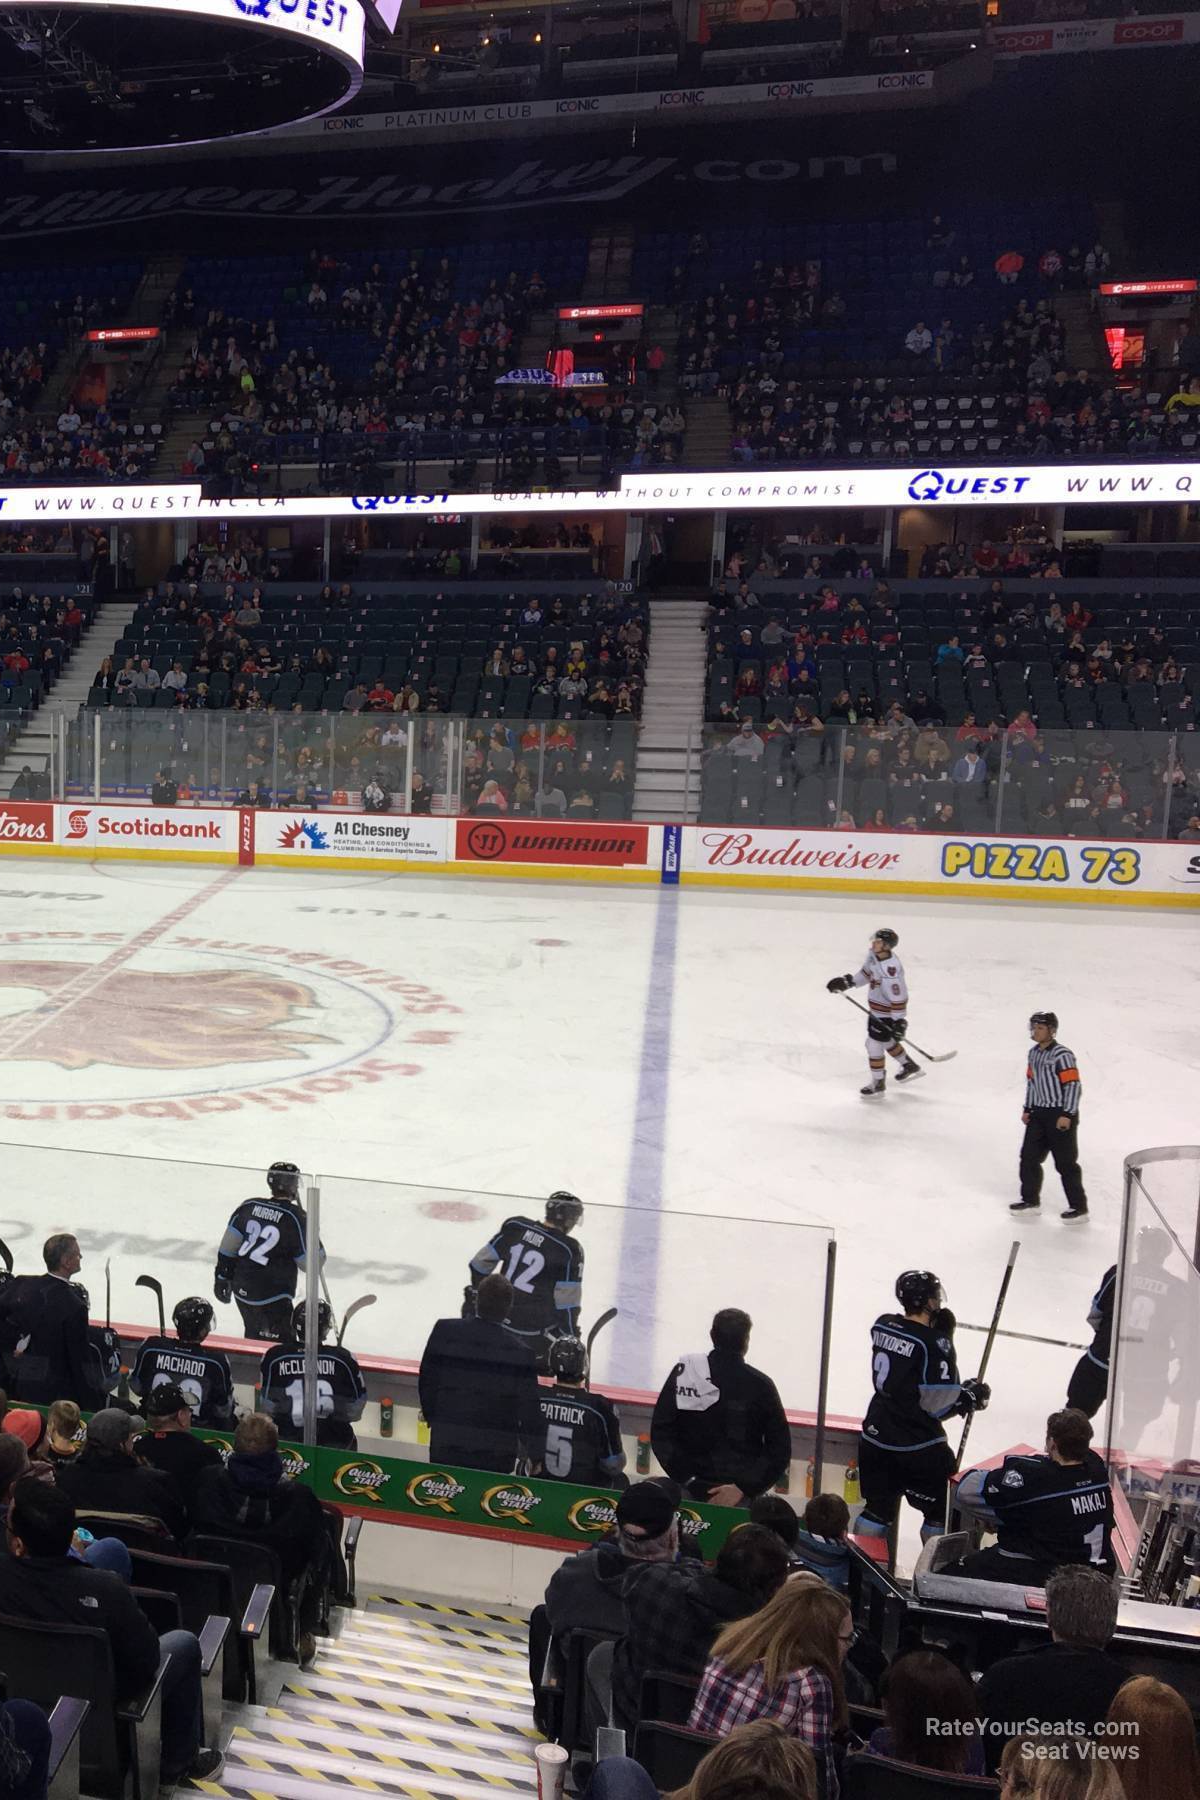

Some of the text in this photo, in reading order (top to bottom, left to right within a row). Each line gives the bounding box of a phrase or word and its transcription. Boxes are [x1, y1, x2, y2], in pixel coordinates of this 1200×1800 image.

[1122, 25, 1175, 38] CO-OP
[767, 83, 814, 98] ICONIC
[878, 74, 926, 88] ICONIC
[660, 91, 705, 105] ICONIC
[324, 99, 599, 130] ICONIC PLATINUM CLUB ICONIC
[708, 483, 857, 497] COMPROMISE
[907, 470, 1031, 500] QUEST
[98, 817, 222, 840] Scotiabank
[242, 814, 252, 852] CCM
[333, 821, 410, 840] A1 Chesney
[511, 833, 637, 854] WARRIOR
[702, 832, 901, 871] Budweiser
[941, 841, 1070, 881] PIZZA
[1081, 847, 1141, 884] 73
[164, 936, 464, 1014] Scotiabank
[251, 1204, 284, 1223] MURRAY
[237, 1219, 282, 1266] 32
[522, 1228, 546, 1248] MUIR
[505, 1242, 546, 1294] 12
[155, 1354, 206, 1377] MACHADO
[279, 1358, 335, 1376] McCLENON
[939, 1360, 951, 1380] 2
[285, 1378, 335, 1428] 16
[540, 1402, 586, 1426] PATRICK
[544, 1424, 575, 1478] 5
[348, 1467, 392, 1483] QUAKER
[352, 1475, 385, 1488] STATE
[421, 1479, 466, 1494] QUAKER
[426, 1487, 458, 1500] STATE
[496, 1490, 542, 1505] QUAKER
[501, 1498, 534, 1512] STATE
[1071, 1495, 1108, 1516] MAKAJ
[584, 1504, 617, 1516] QUAK
